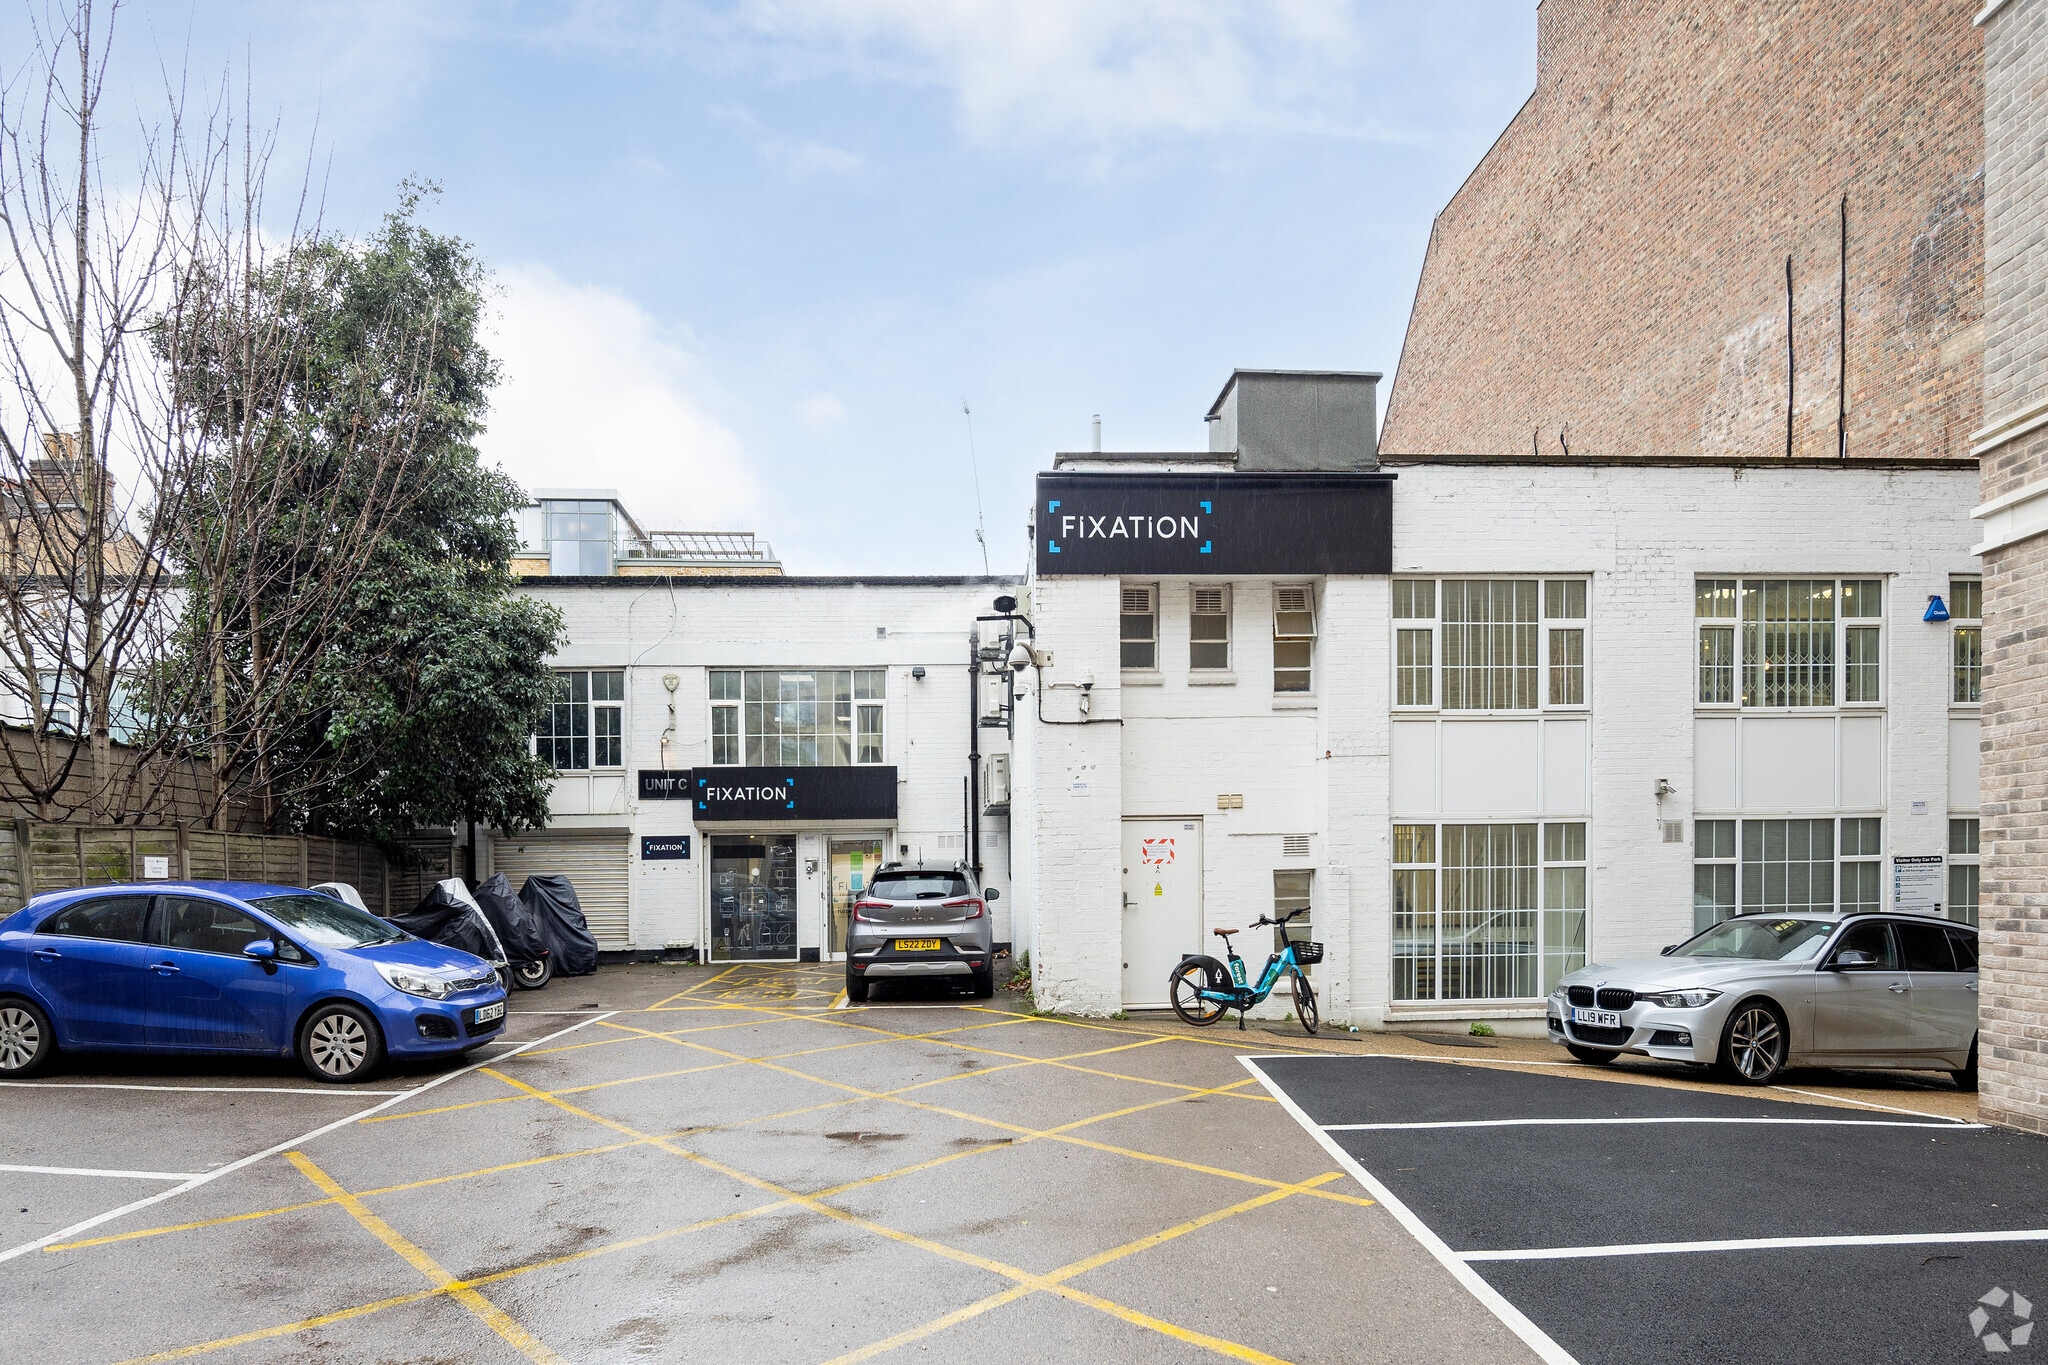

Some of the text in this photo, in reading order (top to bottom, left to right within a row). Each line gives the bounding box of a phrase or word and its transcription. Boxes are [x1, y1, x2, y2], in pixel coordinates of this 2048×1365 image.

[645, 778, 688, 791] UNIT C
[898, 940, 937, 949] LS22 ZDY
[1233, 962, 1244, 985] forest
[1577, 1010, 1616, 1025] LL19 WFR
